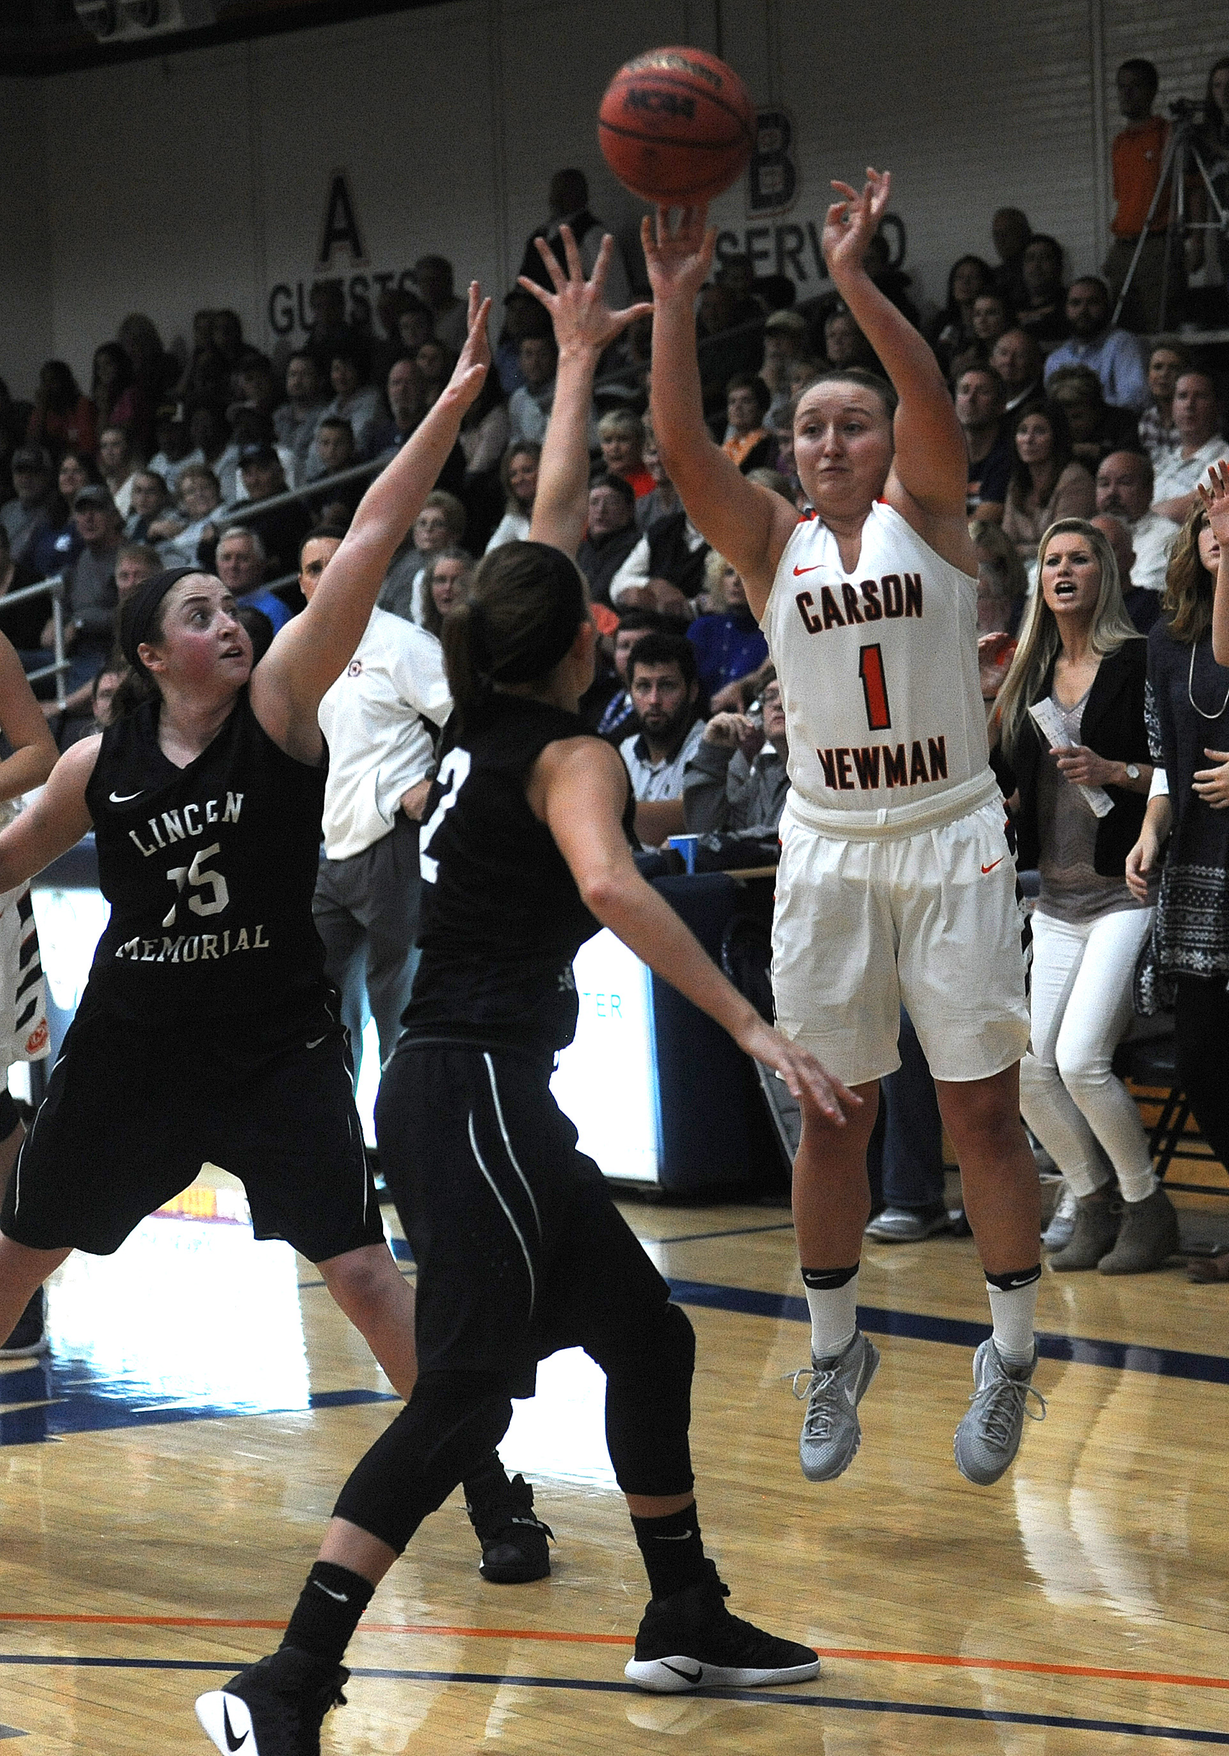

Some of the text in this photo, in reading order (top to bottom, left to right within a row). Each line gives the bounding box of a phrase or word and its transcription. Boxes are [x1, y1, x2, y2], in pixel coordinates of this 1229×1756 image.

[748, 108, 797, 216] B
[317, 170, 366, 268] A
[269, 269, 419, 334] GUSTS
[796, 572, 923, 634] CARSON
[859, 642, 892, 731] 1
[816, 735, 948, 791] NEWMAN
[115, 924, 269, 963] MEMORIAL
